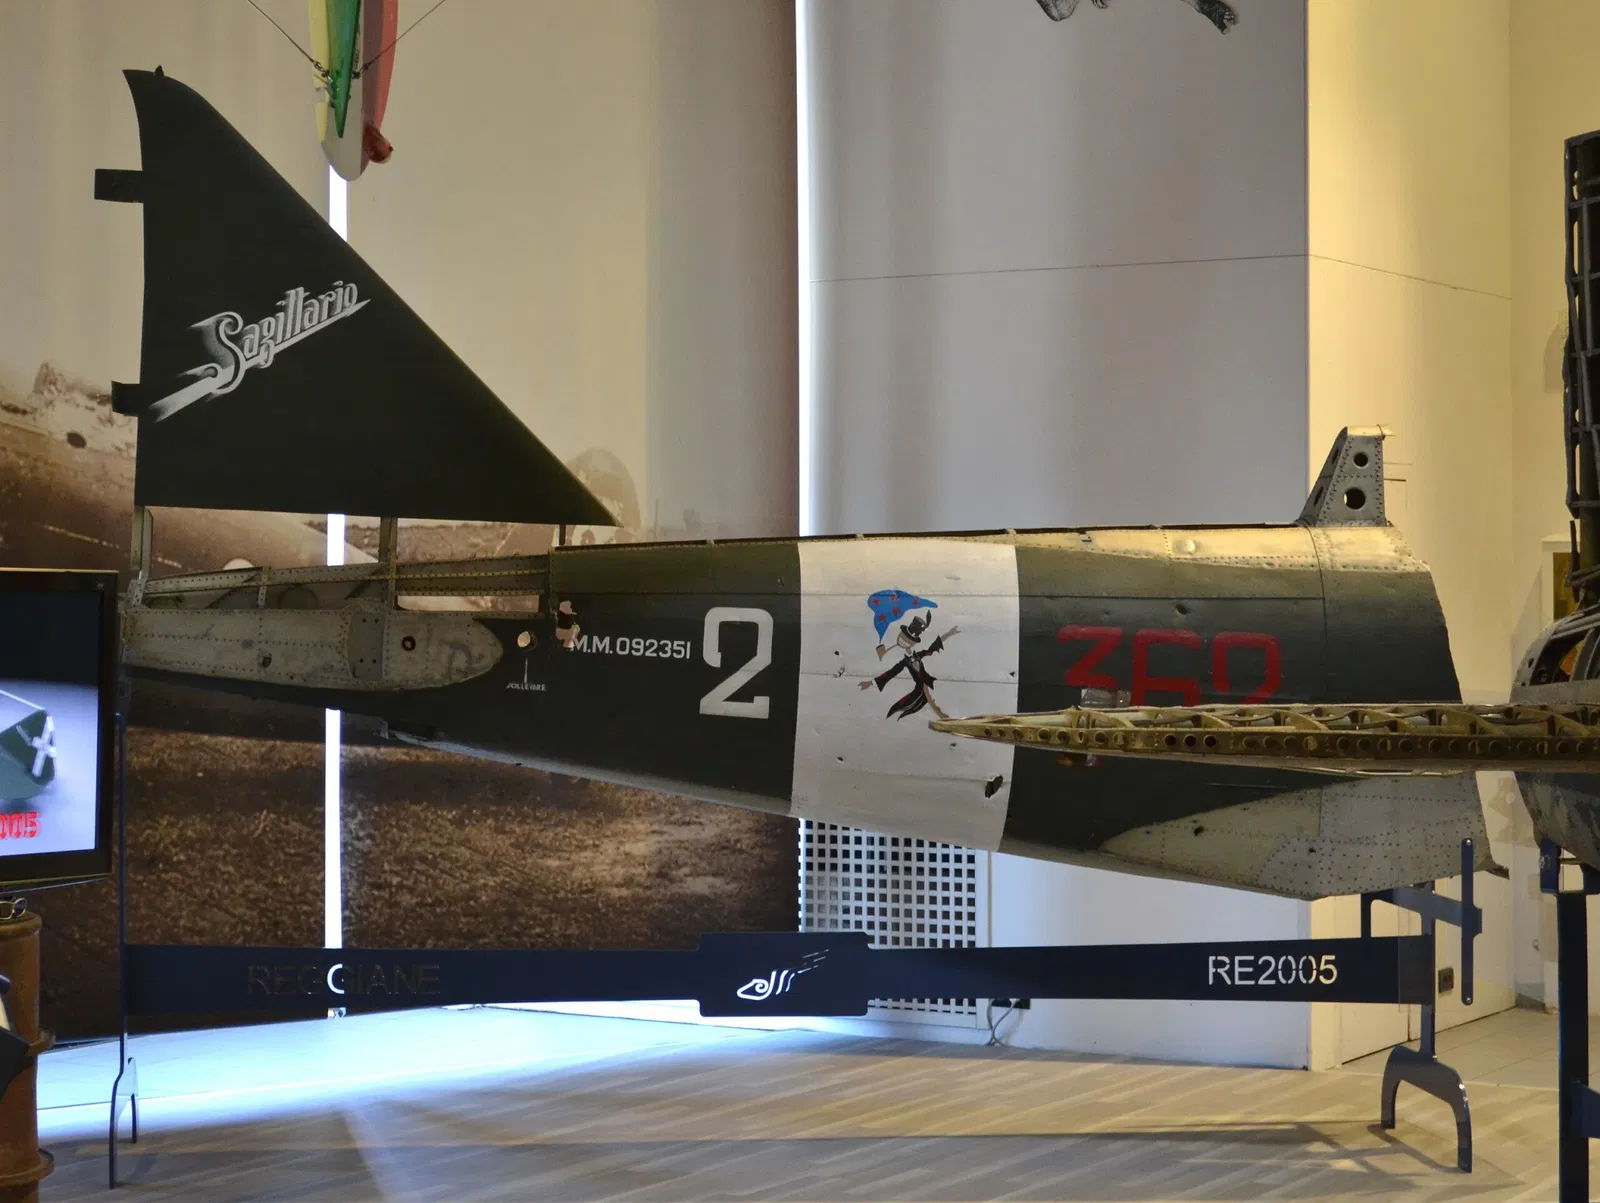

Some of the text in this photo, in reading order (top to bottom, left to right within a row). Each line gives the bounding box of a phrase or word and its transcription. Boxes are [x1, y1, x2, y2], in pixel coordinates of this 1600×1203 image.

[160, 280, 371, 412] Sagittario
[699, 606, 774, 719] 2
[247, 963, 441, 996] REGGIANE
[1208, 954, 1338, 985] RE2005
